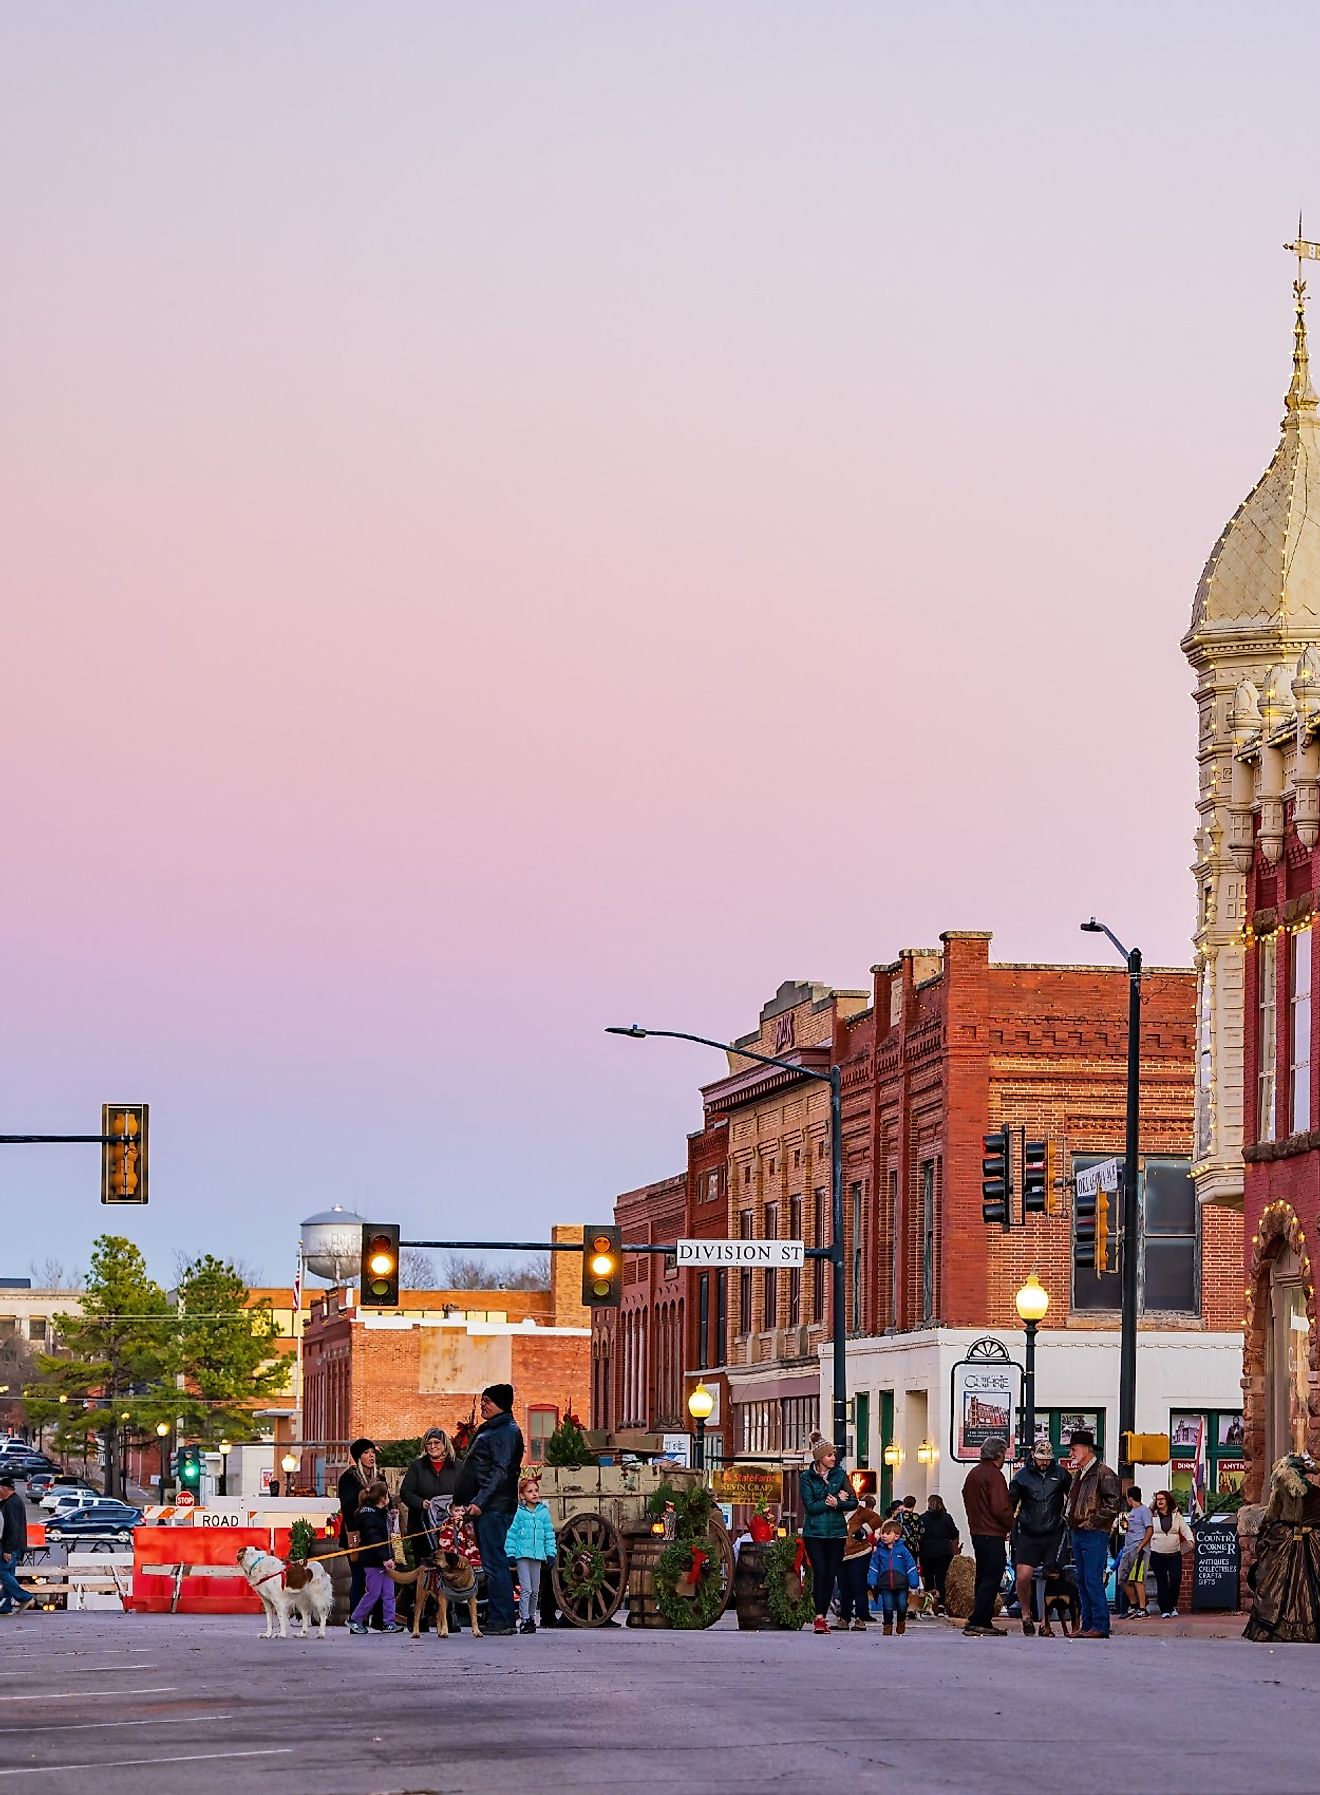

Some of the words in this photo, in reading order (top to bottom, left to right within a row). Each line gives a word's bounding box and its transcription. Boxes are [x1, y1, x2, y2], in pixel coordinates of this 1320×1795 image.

[679, 1244, 772, 1260] DIVISION
[781, 1245, 802, 1260] ST
[177, 1496, 194, 1505] STOP
[202, 1515, 239, 1527] ROAD
[1198, 1565, 1237, 1573] COLLECTIBLES
